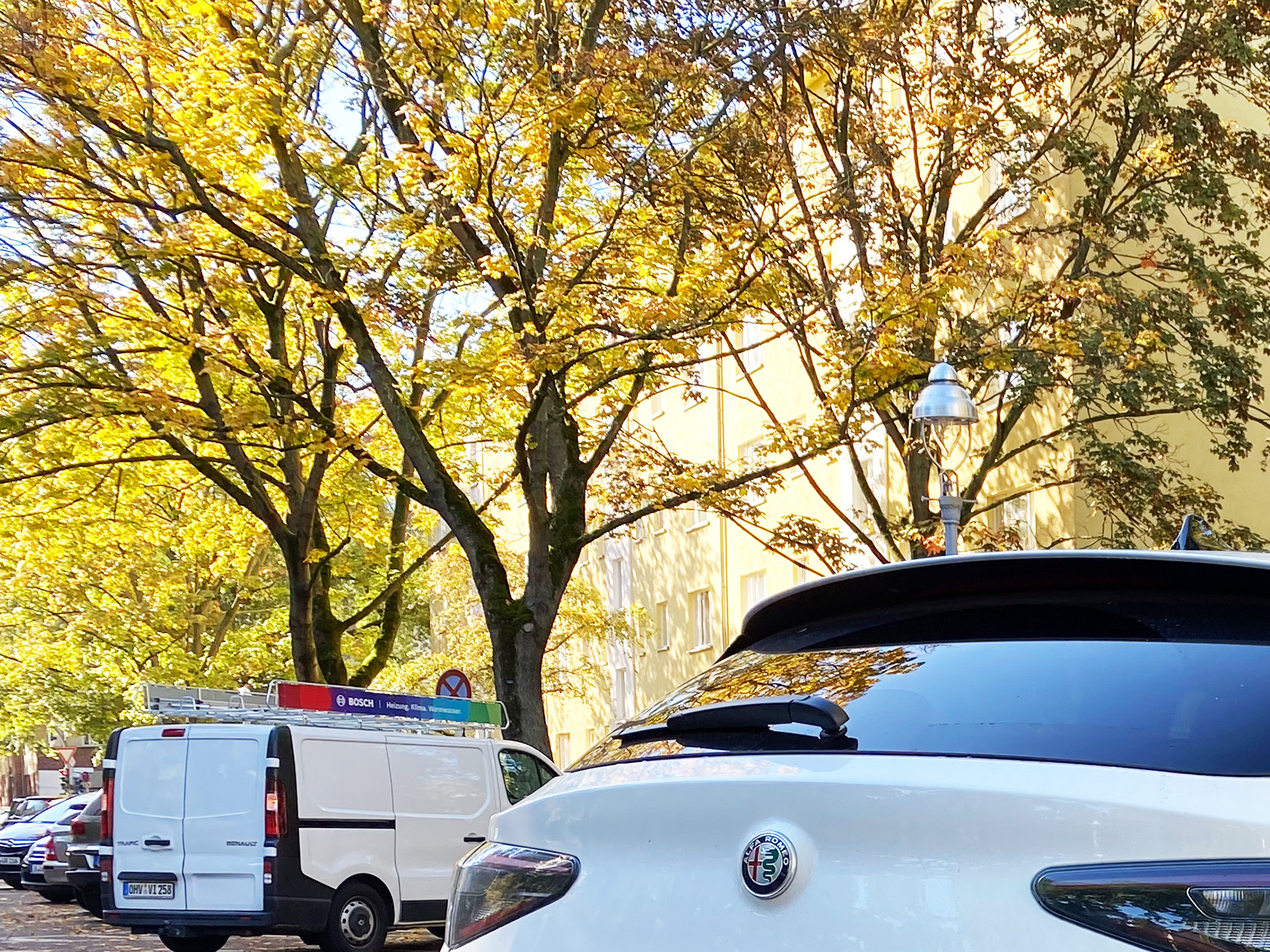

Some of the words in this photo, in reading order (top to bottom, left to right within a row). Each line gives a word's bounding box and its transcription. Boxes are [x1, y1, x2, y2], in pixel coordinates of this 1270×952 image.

[348, 697, 374, 708] BOSCH
[743, 839, 761, 864] ALFA
[765, 836, 789, 866] ROMEO
[129, 884, 143, 895] OHV
[148, 884, 157, 895] VI
[158, 884, 172, 895] 258
